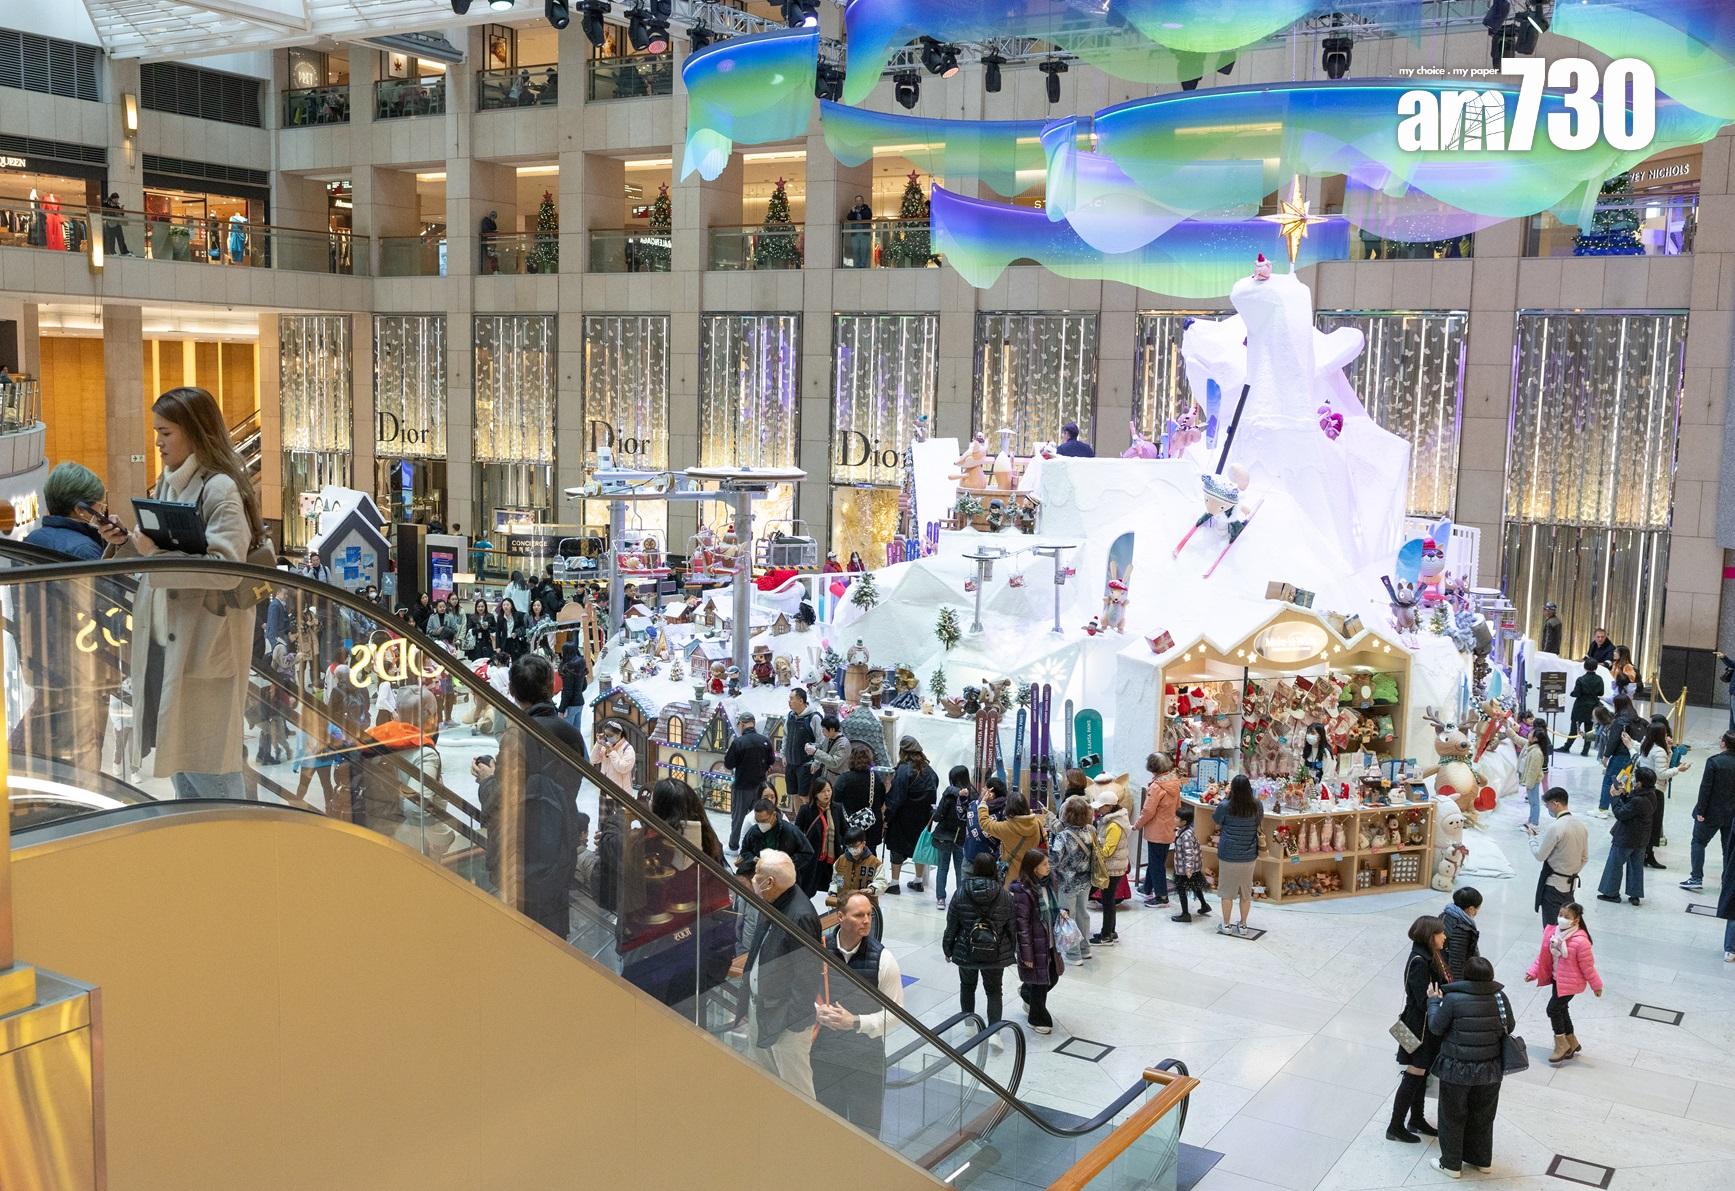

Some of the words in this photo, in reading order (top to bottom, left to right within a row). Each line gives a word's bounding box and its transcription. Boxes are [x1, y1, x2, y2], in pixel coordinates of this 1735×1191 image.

[1648, 163, 1690, 180] NICHOLS
[376, 411, 429, 443] Dior
[587, 420, 650, 454] Dior
